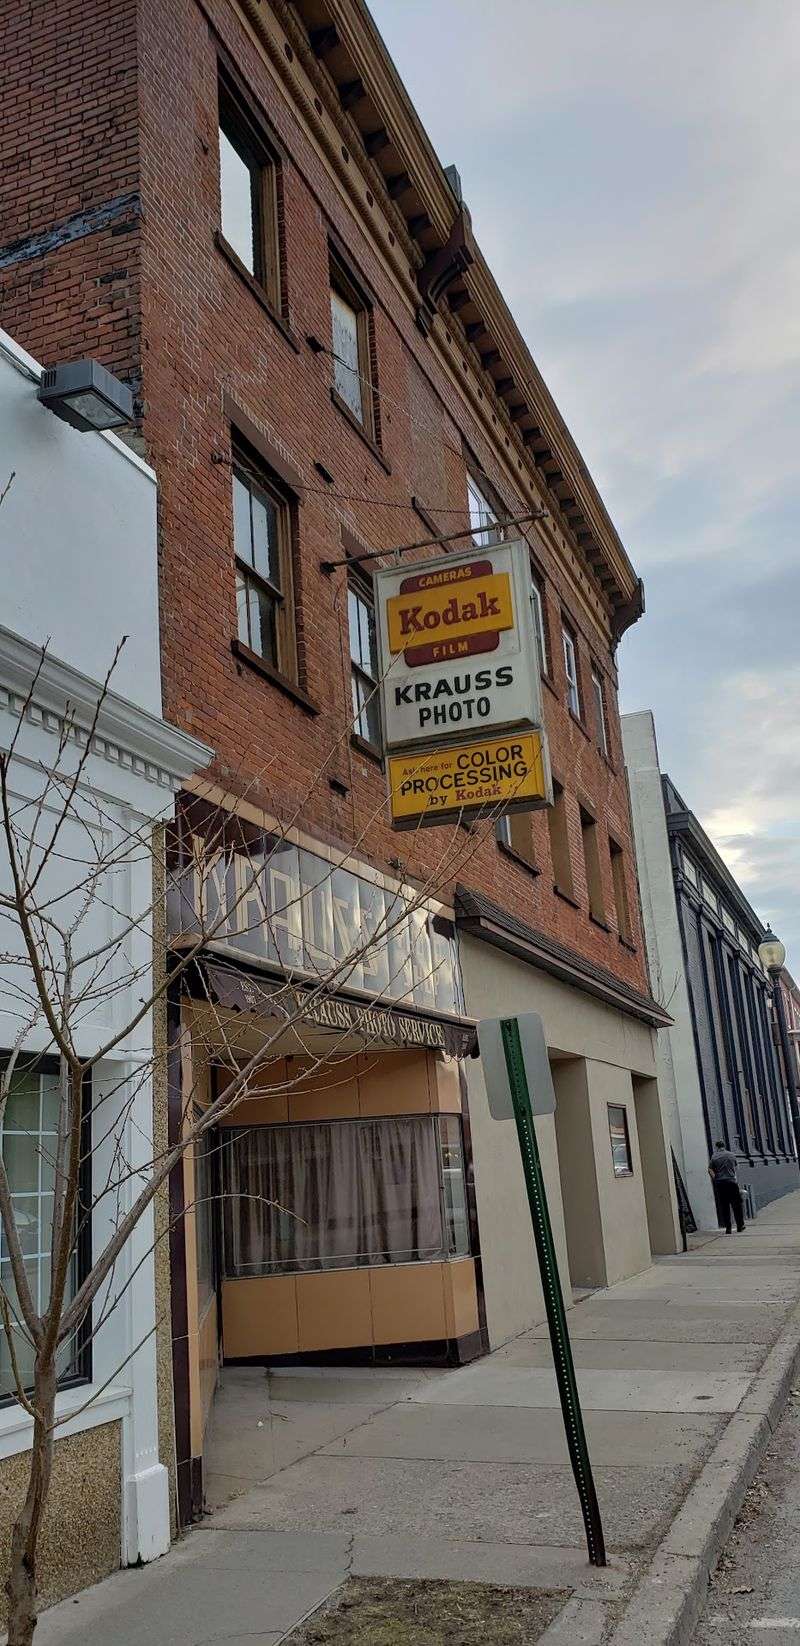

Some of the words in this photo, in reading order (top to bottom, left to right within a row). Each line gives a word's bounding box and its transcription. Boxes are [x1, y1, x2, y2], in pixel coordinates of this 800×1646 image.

[418, 567, 472, 587] CAMERAS
[398, 592, 501, 635] Kodak
[432, 640, 469, 658] FILM
[395, 666, 514, 706] KRAUSS
[418, 697, 491, 728] PHOTO
[457, 744, 523, 770] COLOR
[401, 761, 528, 796] PROCESSING
[429, 795, 448, 806] by
[455, 783, 502, 801] Kodak
[357, 1006, 396, 1038] PHOTO
[399, 1016, 446, 1046] SERVICE
